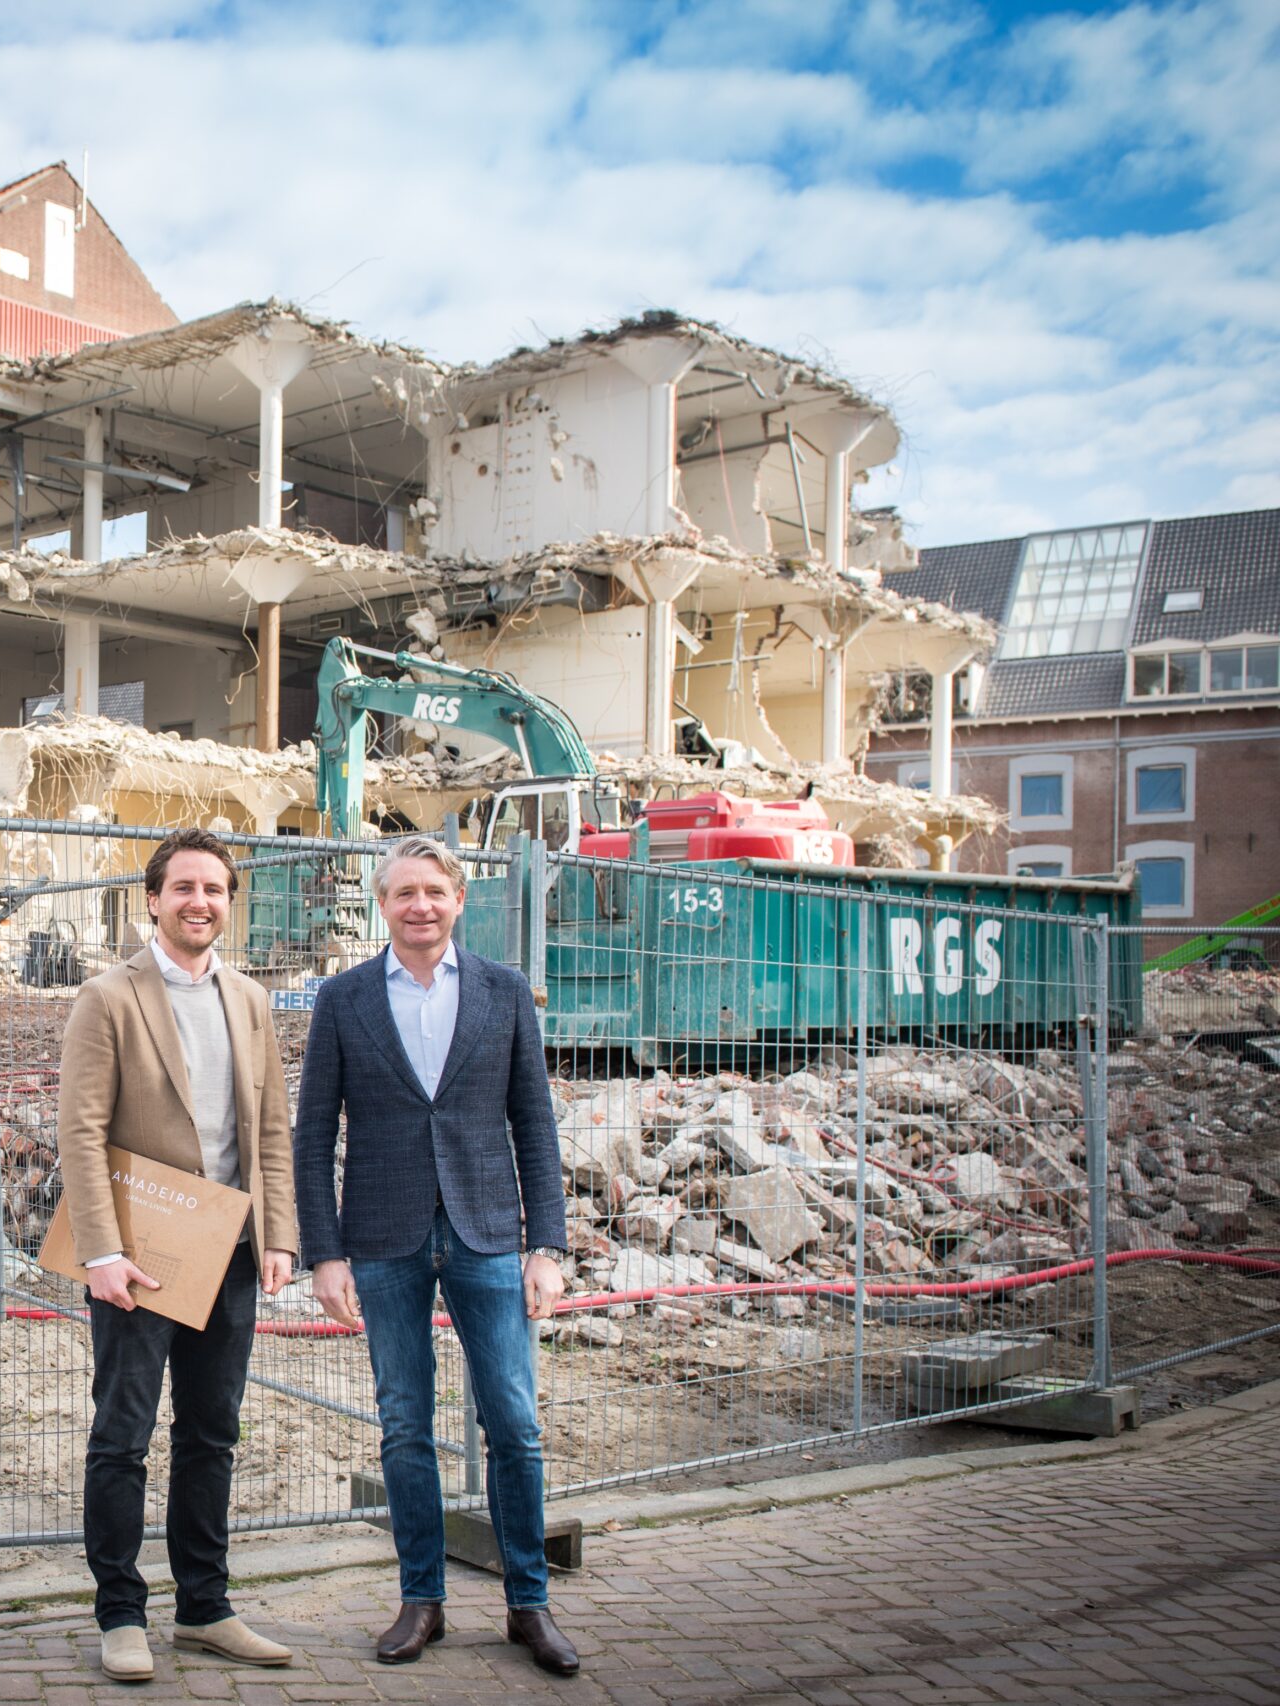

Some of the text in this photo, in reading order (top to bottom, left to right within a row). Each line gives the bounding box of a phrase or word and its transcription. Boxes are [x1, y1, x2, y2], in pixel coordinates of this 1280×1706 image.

[412, 693, 461, 723] RGS
[793, 834, 834, 865] RGS
[669, 887, 723, 913] 15-3
[890, 917, 1003, 996] RGS
[112, 1170, 197, 1209] AMADEIRO
[125, 1194, 173, 1215] URBAN LIVING
